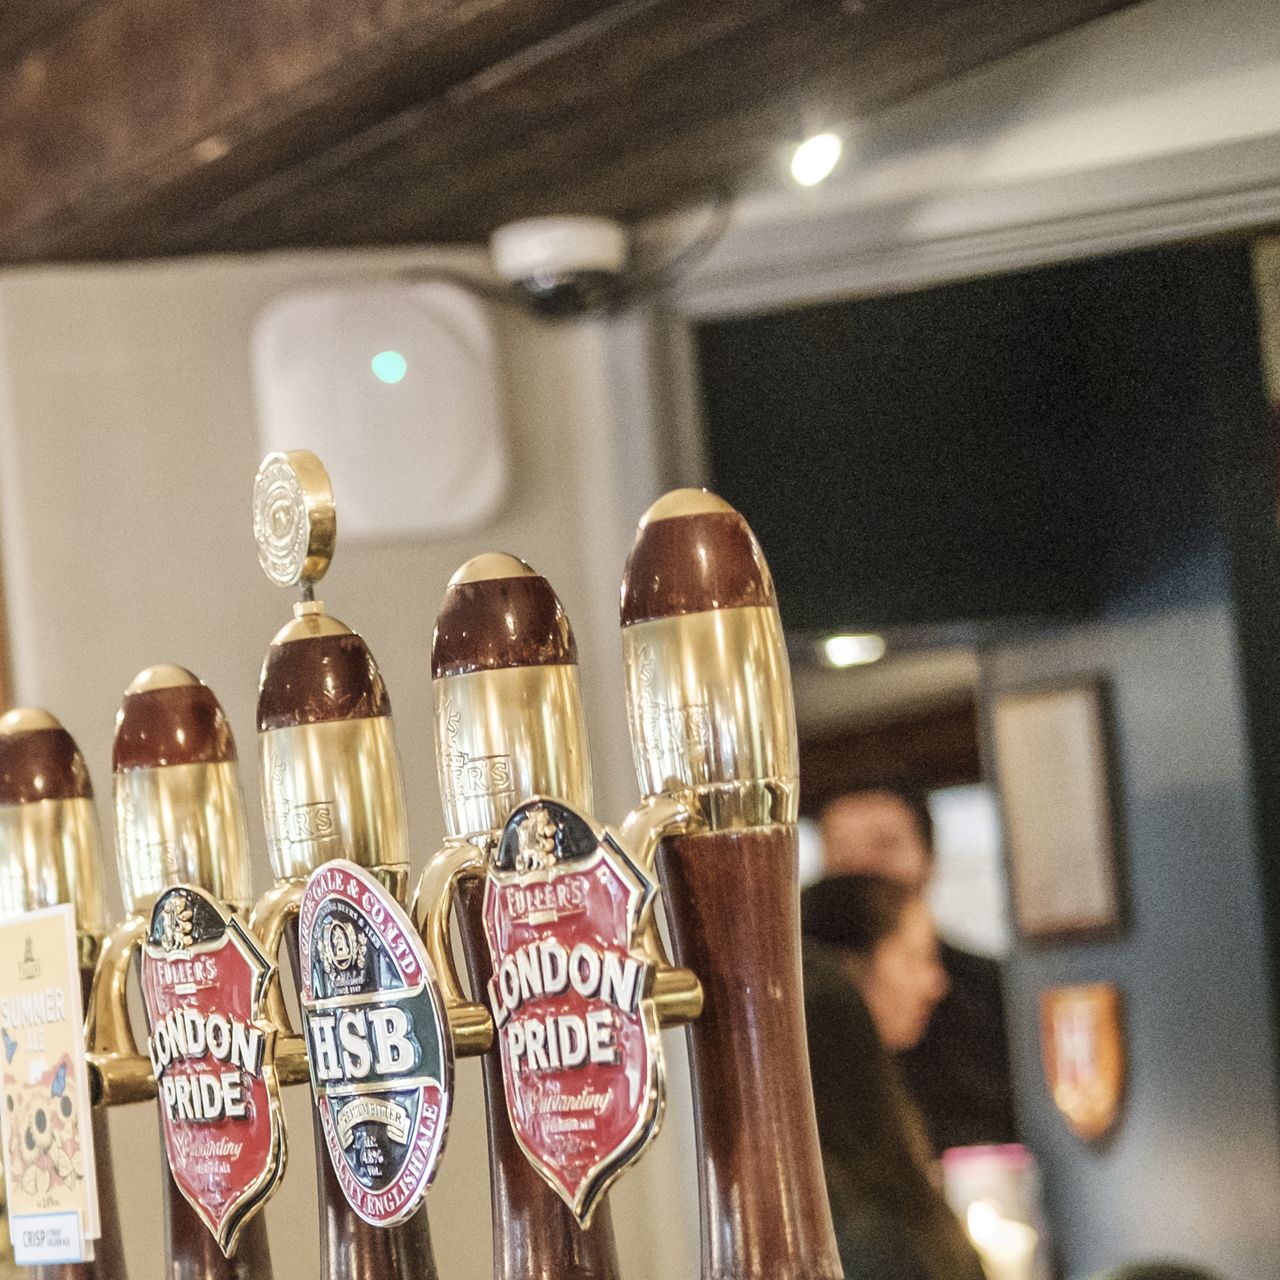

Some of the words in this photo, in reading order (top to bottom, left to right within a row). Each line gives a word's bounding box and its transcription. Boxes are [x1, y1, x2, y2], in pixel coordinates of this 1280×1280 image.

[312, 870, 345, 901] GALE
[346, 878, 360, 899] &
[361, 892, 385, 931] CO.
[385, 922, 417, 974] LTD
[506, 877, 584, 917] FULLER'S
[157, 957, 217, 985] FULLER'S
[487, 937, 640, 1028] LONDON
[0, 987, 65, 1030] SUMMER
[148, 1007, 261, 1081] LONDON
[309, 1007, 416, 1081] HSB
[506, 1010, 617, 1075] PRIDE
[162, 1072, 247, 1121] PRIDE
[363, 1154, 427, 1216] ENGLISH
[415, 1102, 439, 1160] ALE
[23, 1229, 46, 1249] CRISP
